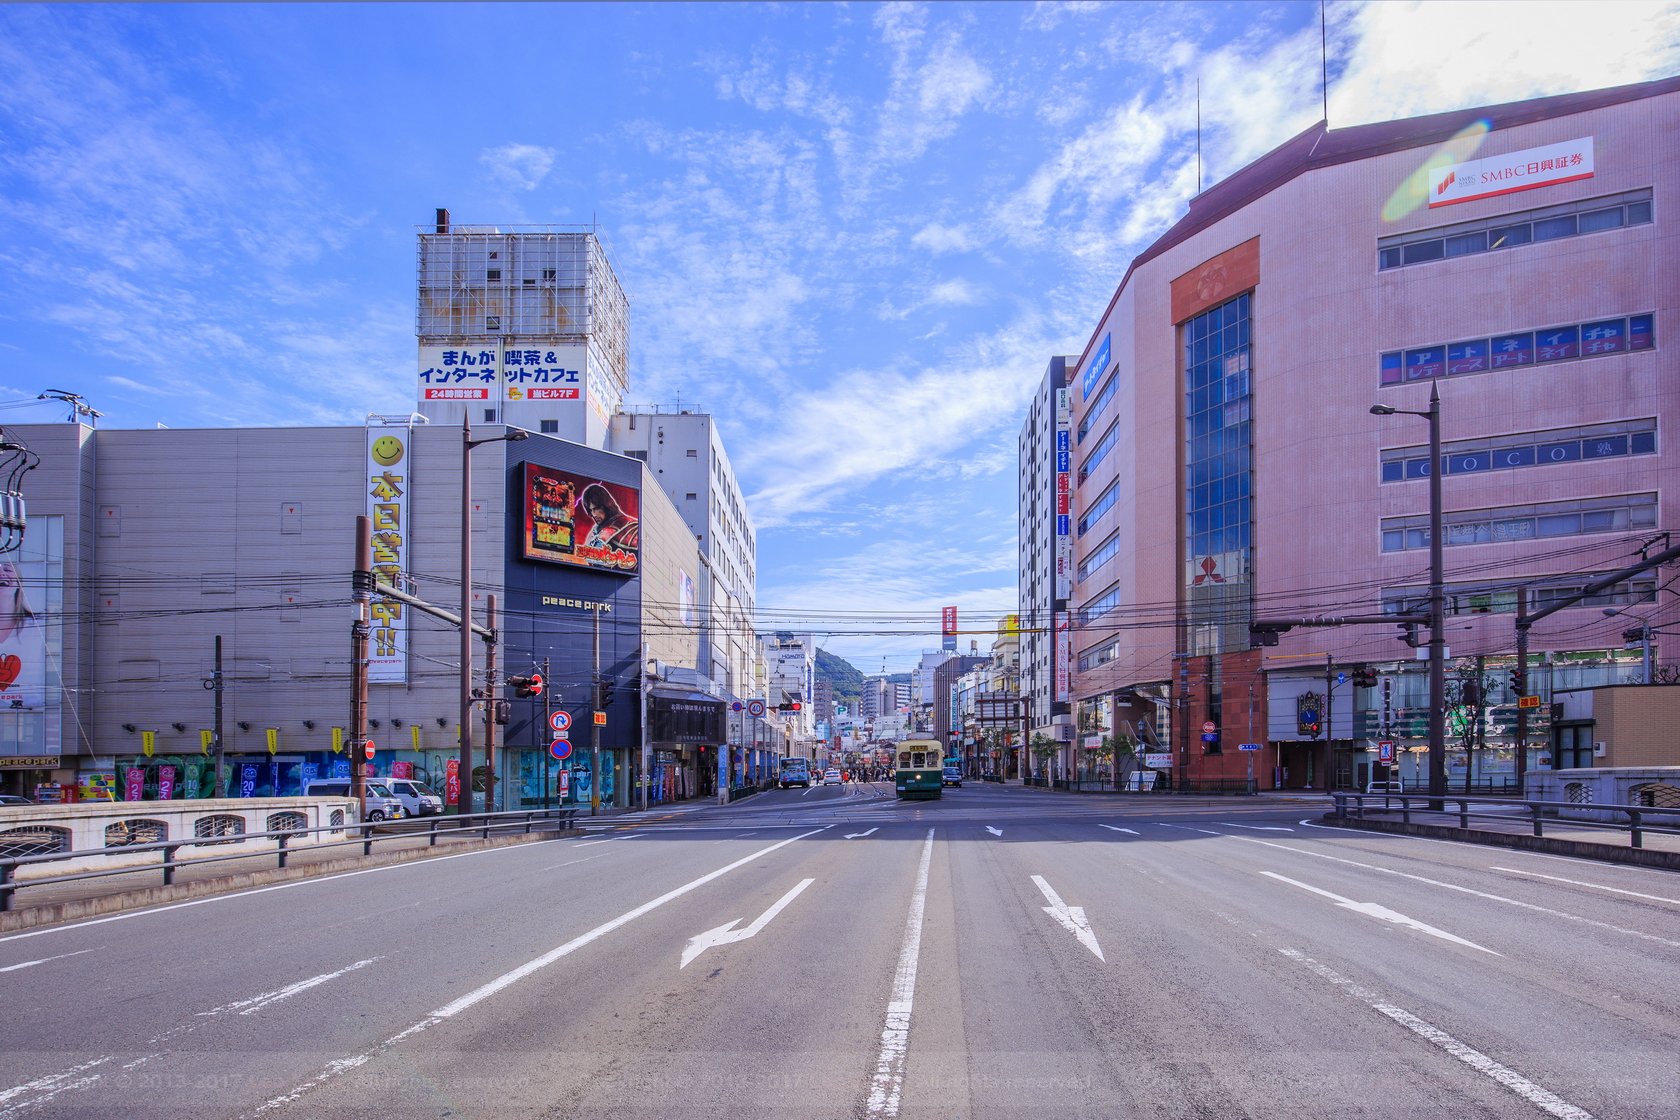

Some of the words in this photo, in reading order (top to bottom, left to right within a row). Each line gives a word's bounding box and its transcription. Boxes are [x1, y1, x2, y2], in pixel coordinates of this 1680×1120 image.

[1481, 153, 1584, 184] SMBC日興証券
[1416, 326, 1645, 365] アートネイチャー
[419, 367, 580, 383] インターネットカフェ
[542, 596, 582, 607] peace
[1520, 696, 1539, 708] 確認
[33, 757, 58, 766] park
